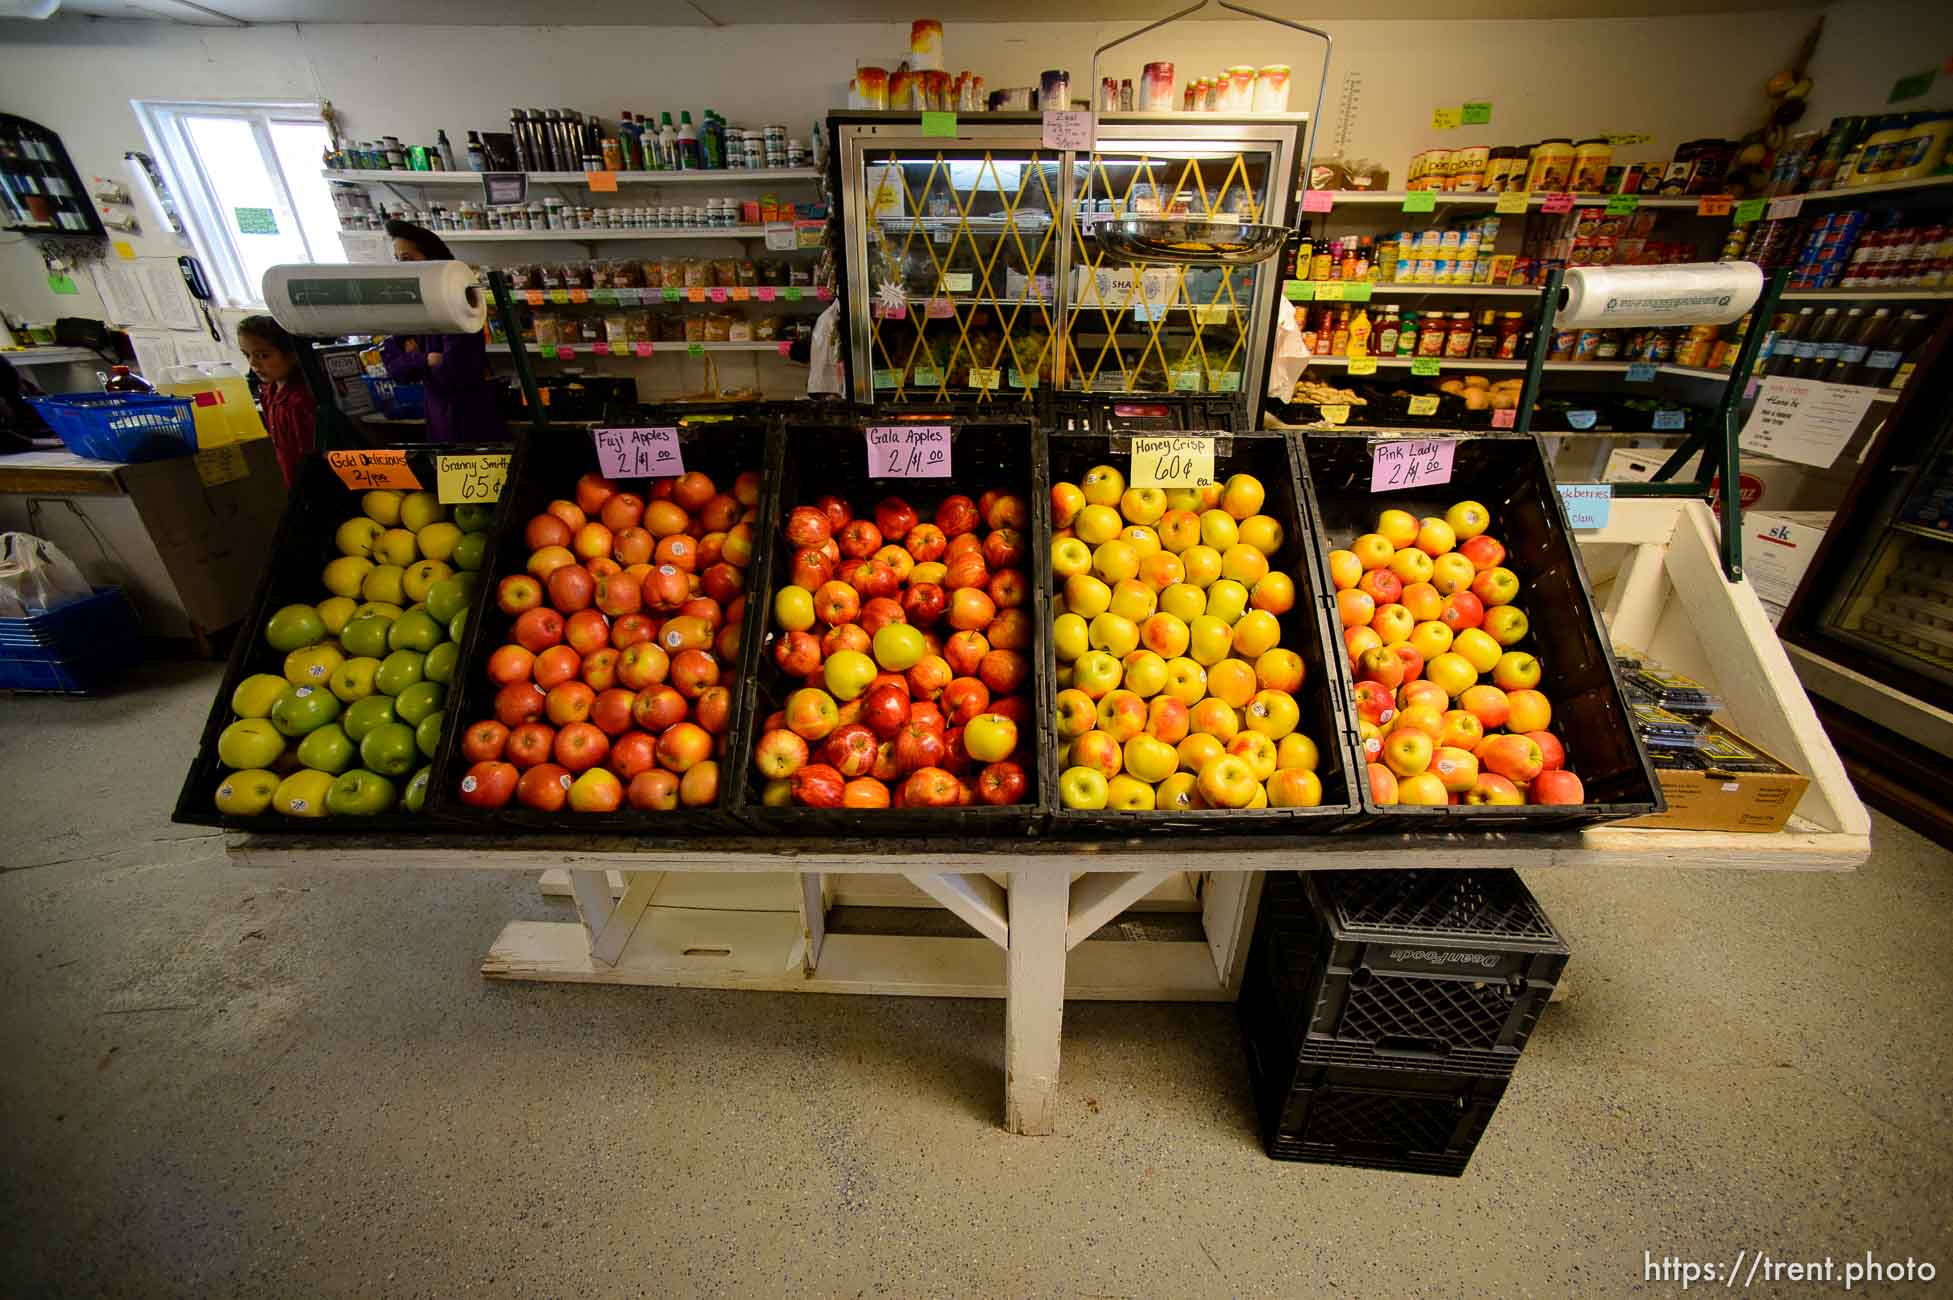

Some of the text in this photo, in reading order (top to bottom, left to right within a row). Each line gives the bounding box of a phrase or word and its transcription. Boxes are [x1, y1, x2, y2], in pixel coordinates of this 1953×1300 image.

[598, 429, 670, 453] Fuji Apples
[870, 428, 943, 446] Gala Apples
[1136, 438, 1206, 456] Honey Crisp
[1376, 442, 1439, 464] Pink Lady
[330, 452, 407, 468] Gold Delicious
[441, 457, 477, 477] Granny
[1768, 525, 1791, 539] sk
